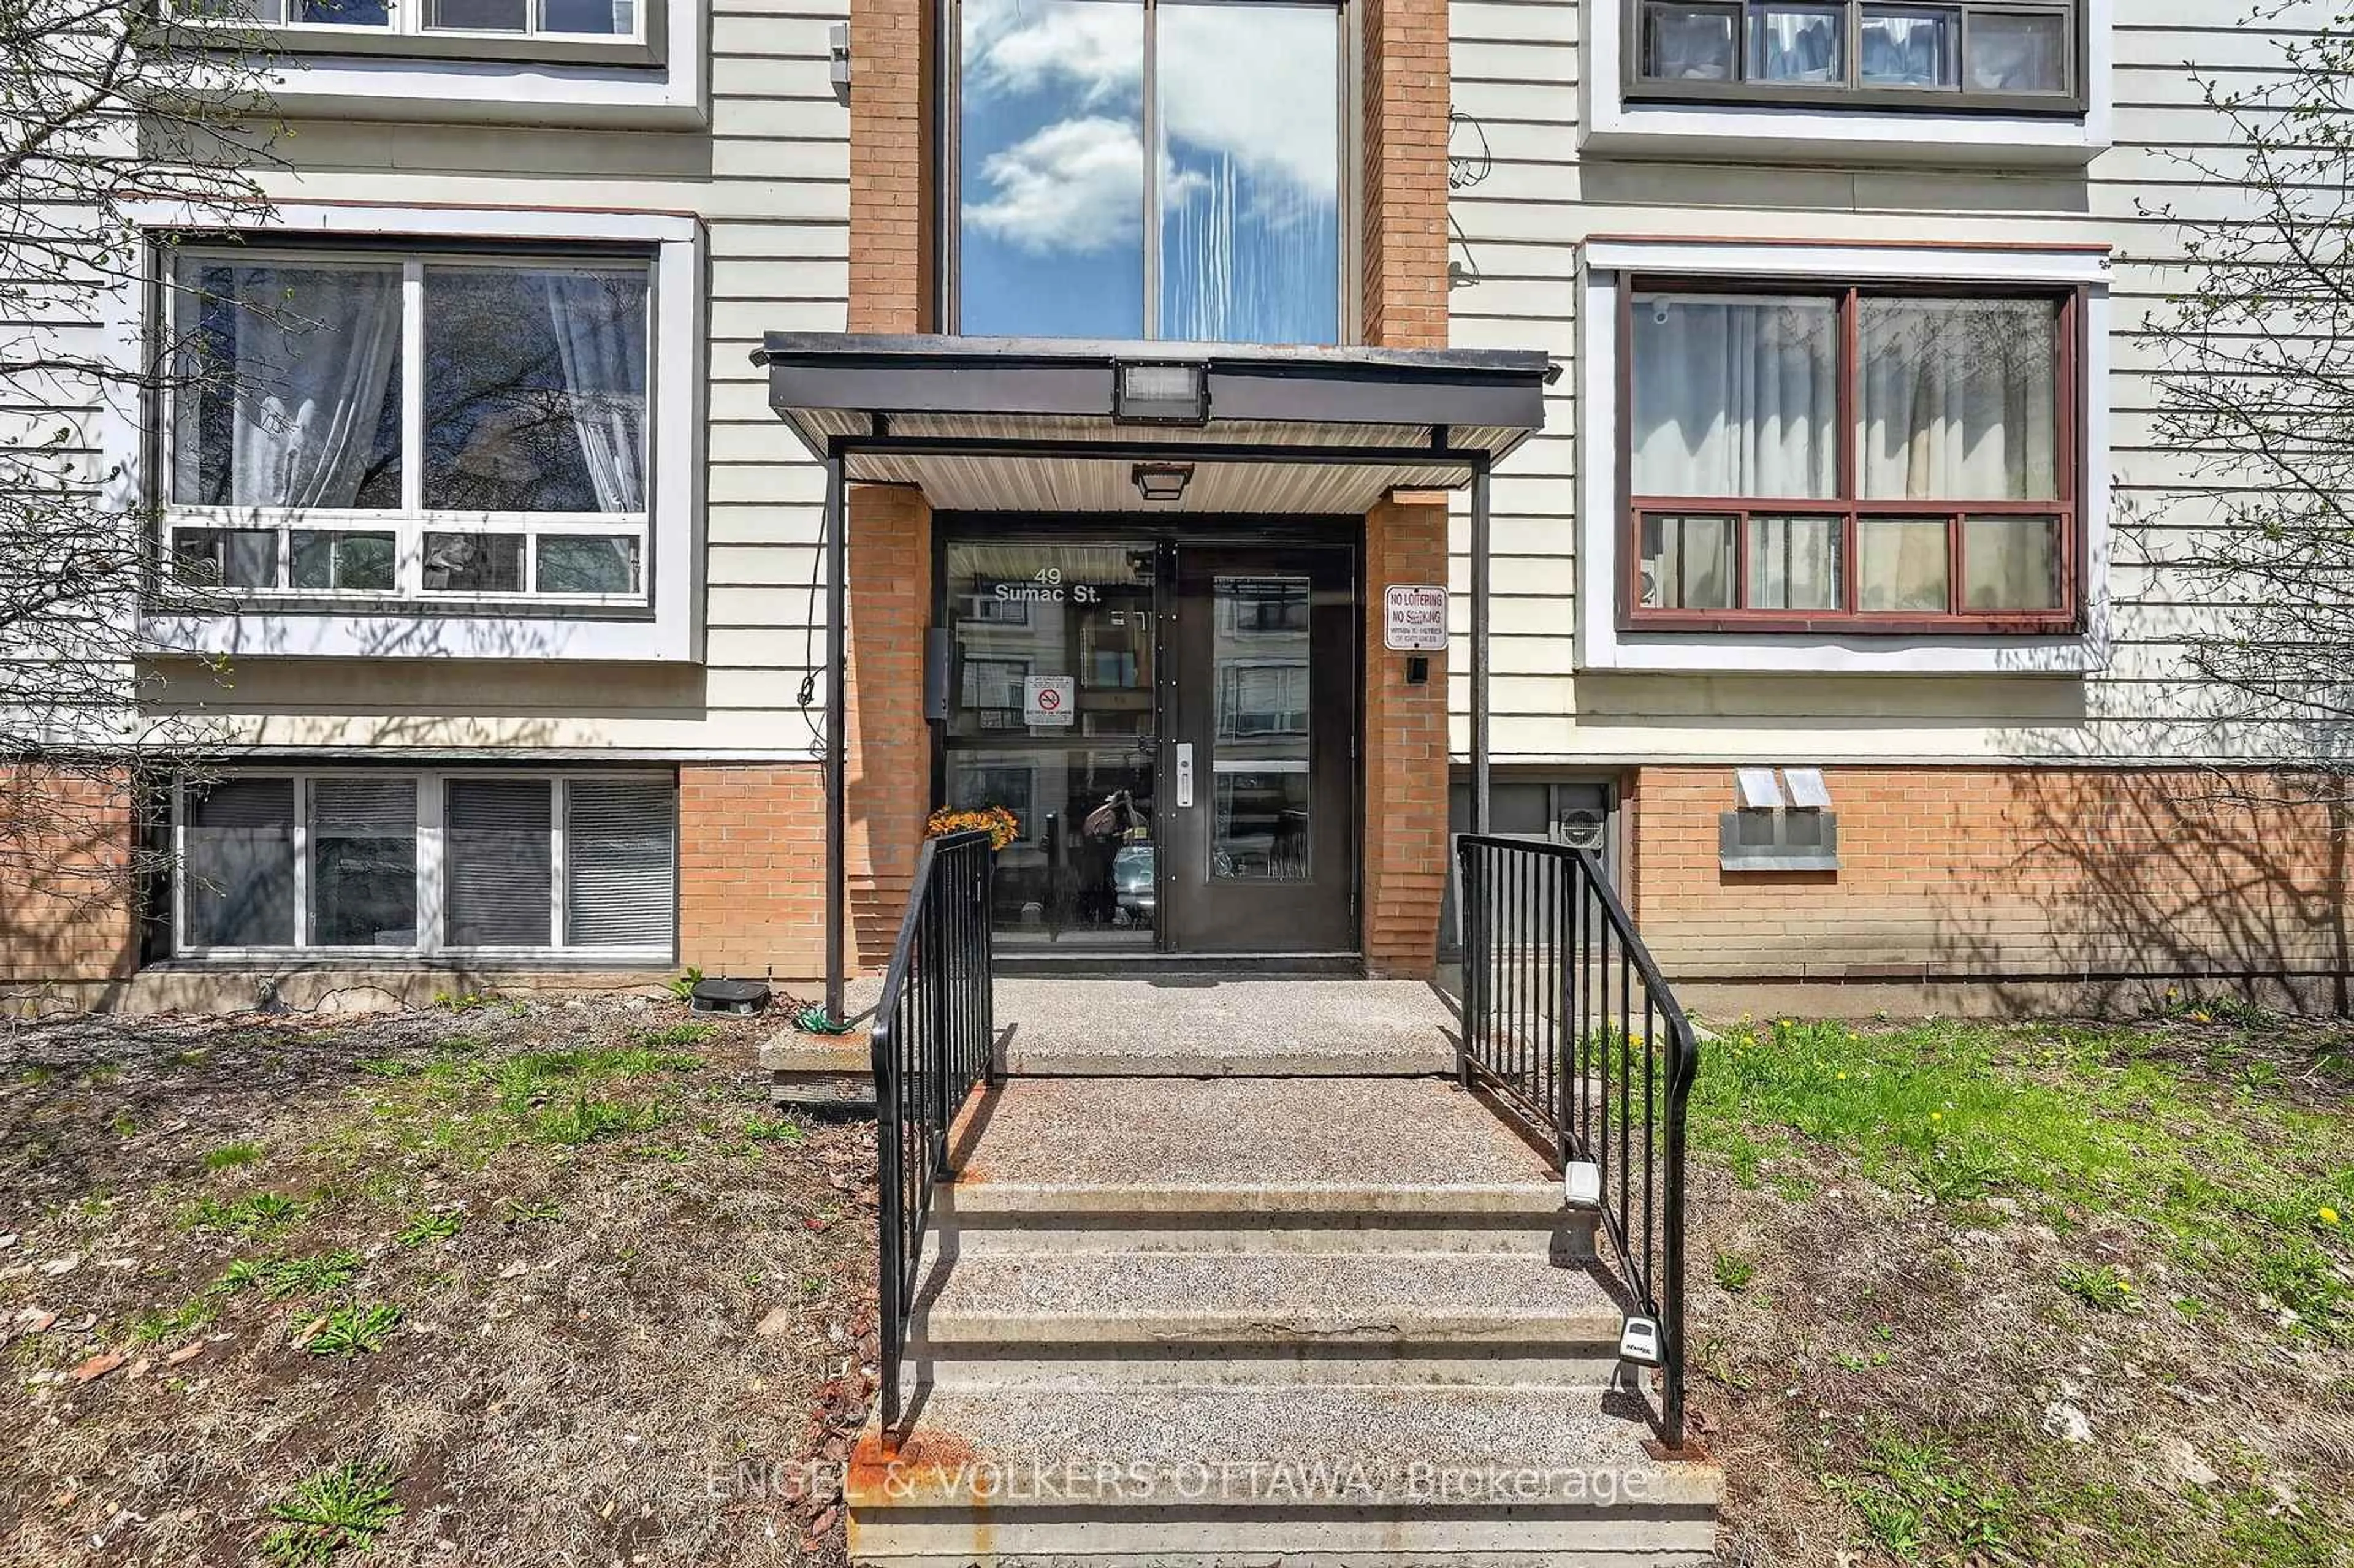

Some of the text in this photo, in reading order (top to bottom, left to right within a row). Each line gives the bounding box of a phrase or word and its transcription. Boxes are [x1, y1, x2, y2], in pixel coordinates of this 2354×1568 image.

[1034, 568, 1061, 585] 49
[994, 584, 1102, 603] Sumac St.
[1391, 593, 1402, 606] NO
[1393, 610, 1404, 623] NO
